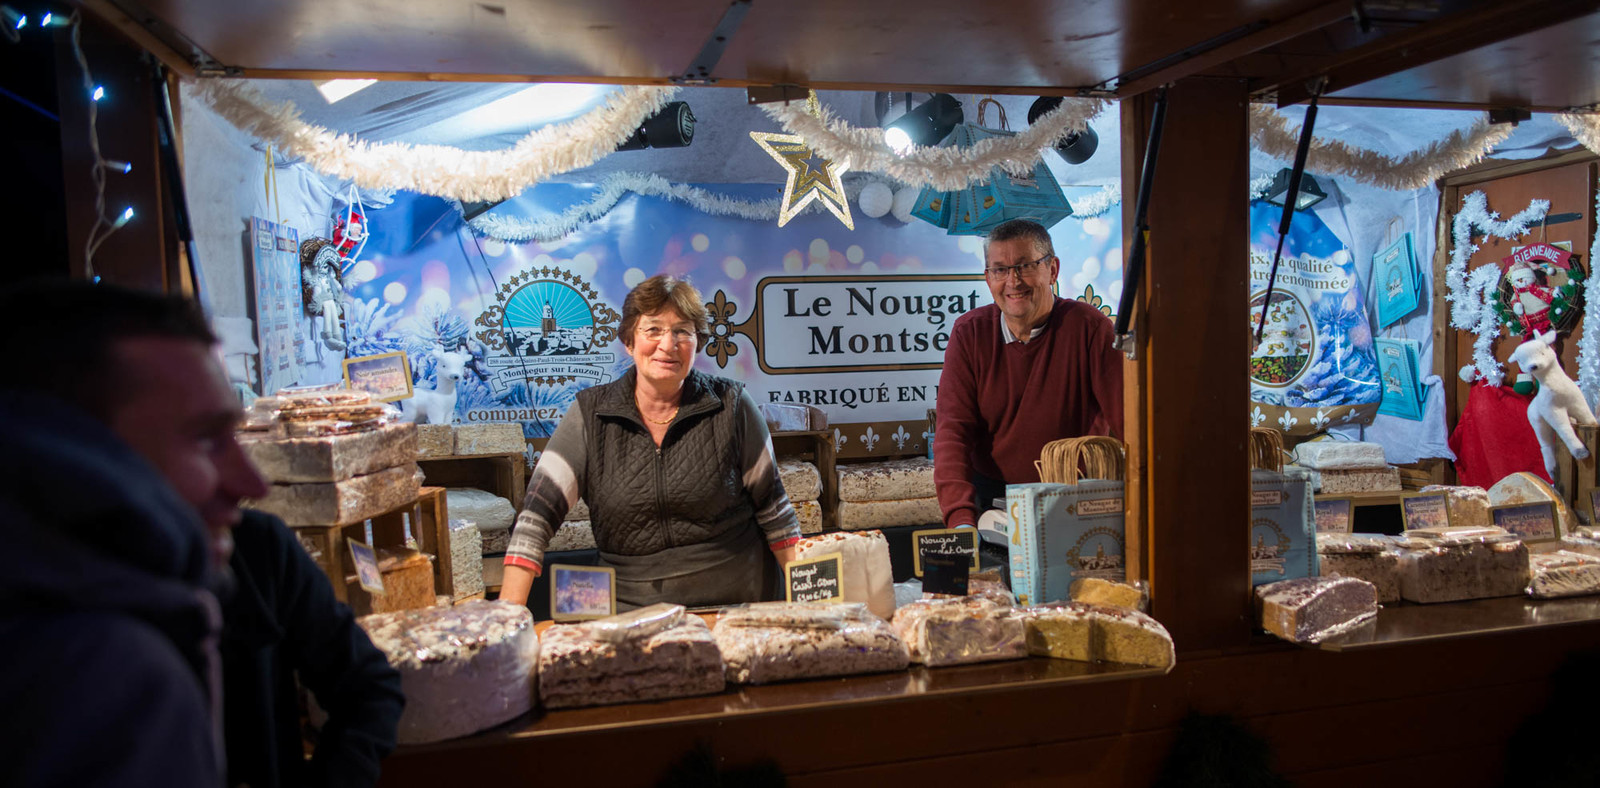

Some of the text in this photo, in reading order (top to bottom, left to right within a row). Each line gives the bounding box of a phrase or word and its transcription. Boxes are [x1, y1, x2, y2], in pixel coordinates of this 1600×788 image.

[1513, 245, 1561, 264] BIENVENUE
[1289, 259, 1333, 273] qualité
[1250, 269, 1348, 289] tre renommée
[783, 287, 980, 325] Le Nougat
[567, 366, 600, 377] Lauzon
[768, 382, 890, 410] FABRIQUÉ
[897, 386, 927, 402] EN
[468, 407, 564, 423] comparez.
[920, 534, 959, 550] Nougat
[791, 564, 818, 584] Nougat
